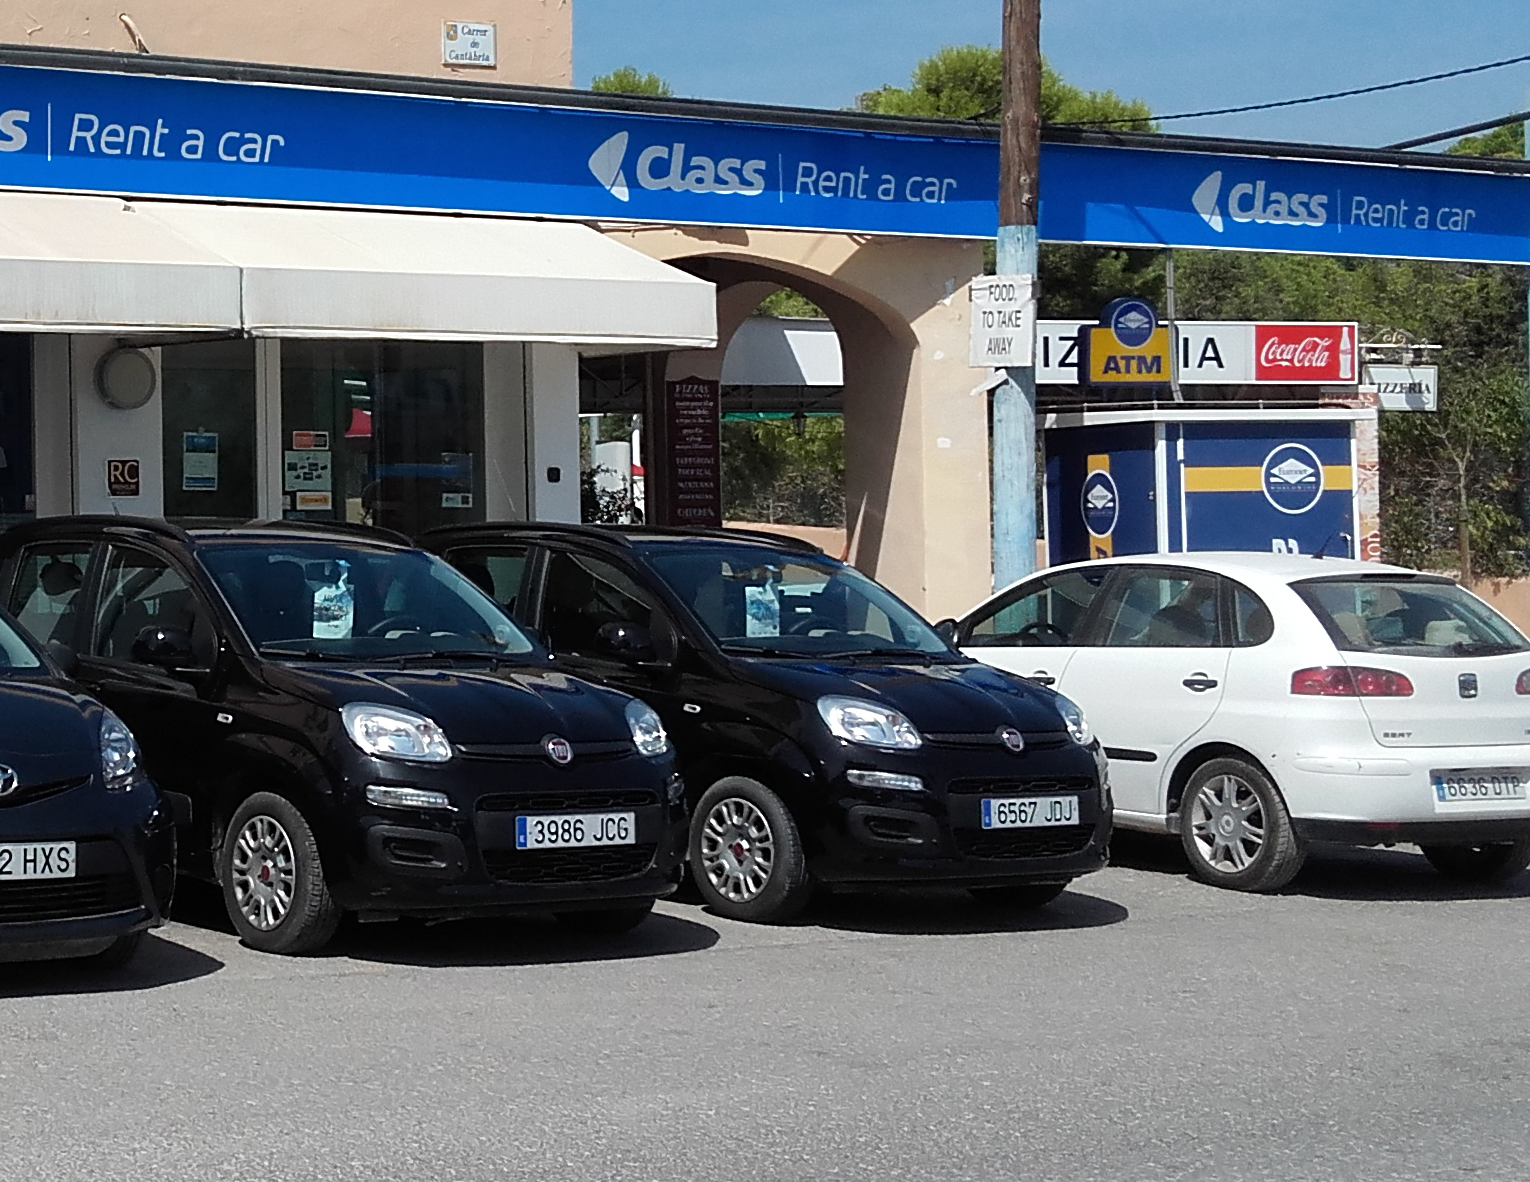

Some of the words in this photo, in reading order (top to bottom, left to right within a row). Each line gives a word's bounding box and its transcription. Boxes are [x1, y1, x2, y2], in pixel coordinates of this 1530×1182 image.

[461, 25, 488, 36] Carrer
[470, 38, 480, 49] de
[69, 113, 169, 159] Rent
[180, 130, 203, 160] a
[219, 131, 285, 163] car
[636, 143, 766, 197] Class
[795, 161, 869, 200] Rent
[877, 174, 896, 201] a
[905, 176, 958, 205] car
[1228, 180, 1328, 227] Class
[1350, 196, 1408, 229] Rent
[1415, 206, 1429, 230] a
[1436, 207, 1476, 232] car
[982, 310, 995, 329] TO
[996, 310, 1022, 328] TAKE
[986, 336, 1013, 355] AWAY
[1260, 336, 1333, 367] Coca-Cola
[1103, 355, 1162, 375] ATM
[110, 461, 138, 483] RC
[1446, 777, 1488, 797] 6636
[1491, 776, 1520, 795] DTP
[998, 802, 1038, 825] 6567
[1044, 800, 1072, 823] JDJ
[534, 819, 584, 844] 3986
[593, 817, 628, 842] JCG
[23, 847, 70, 875] HXS
